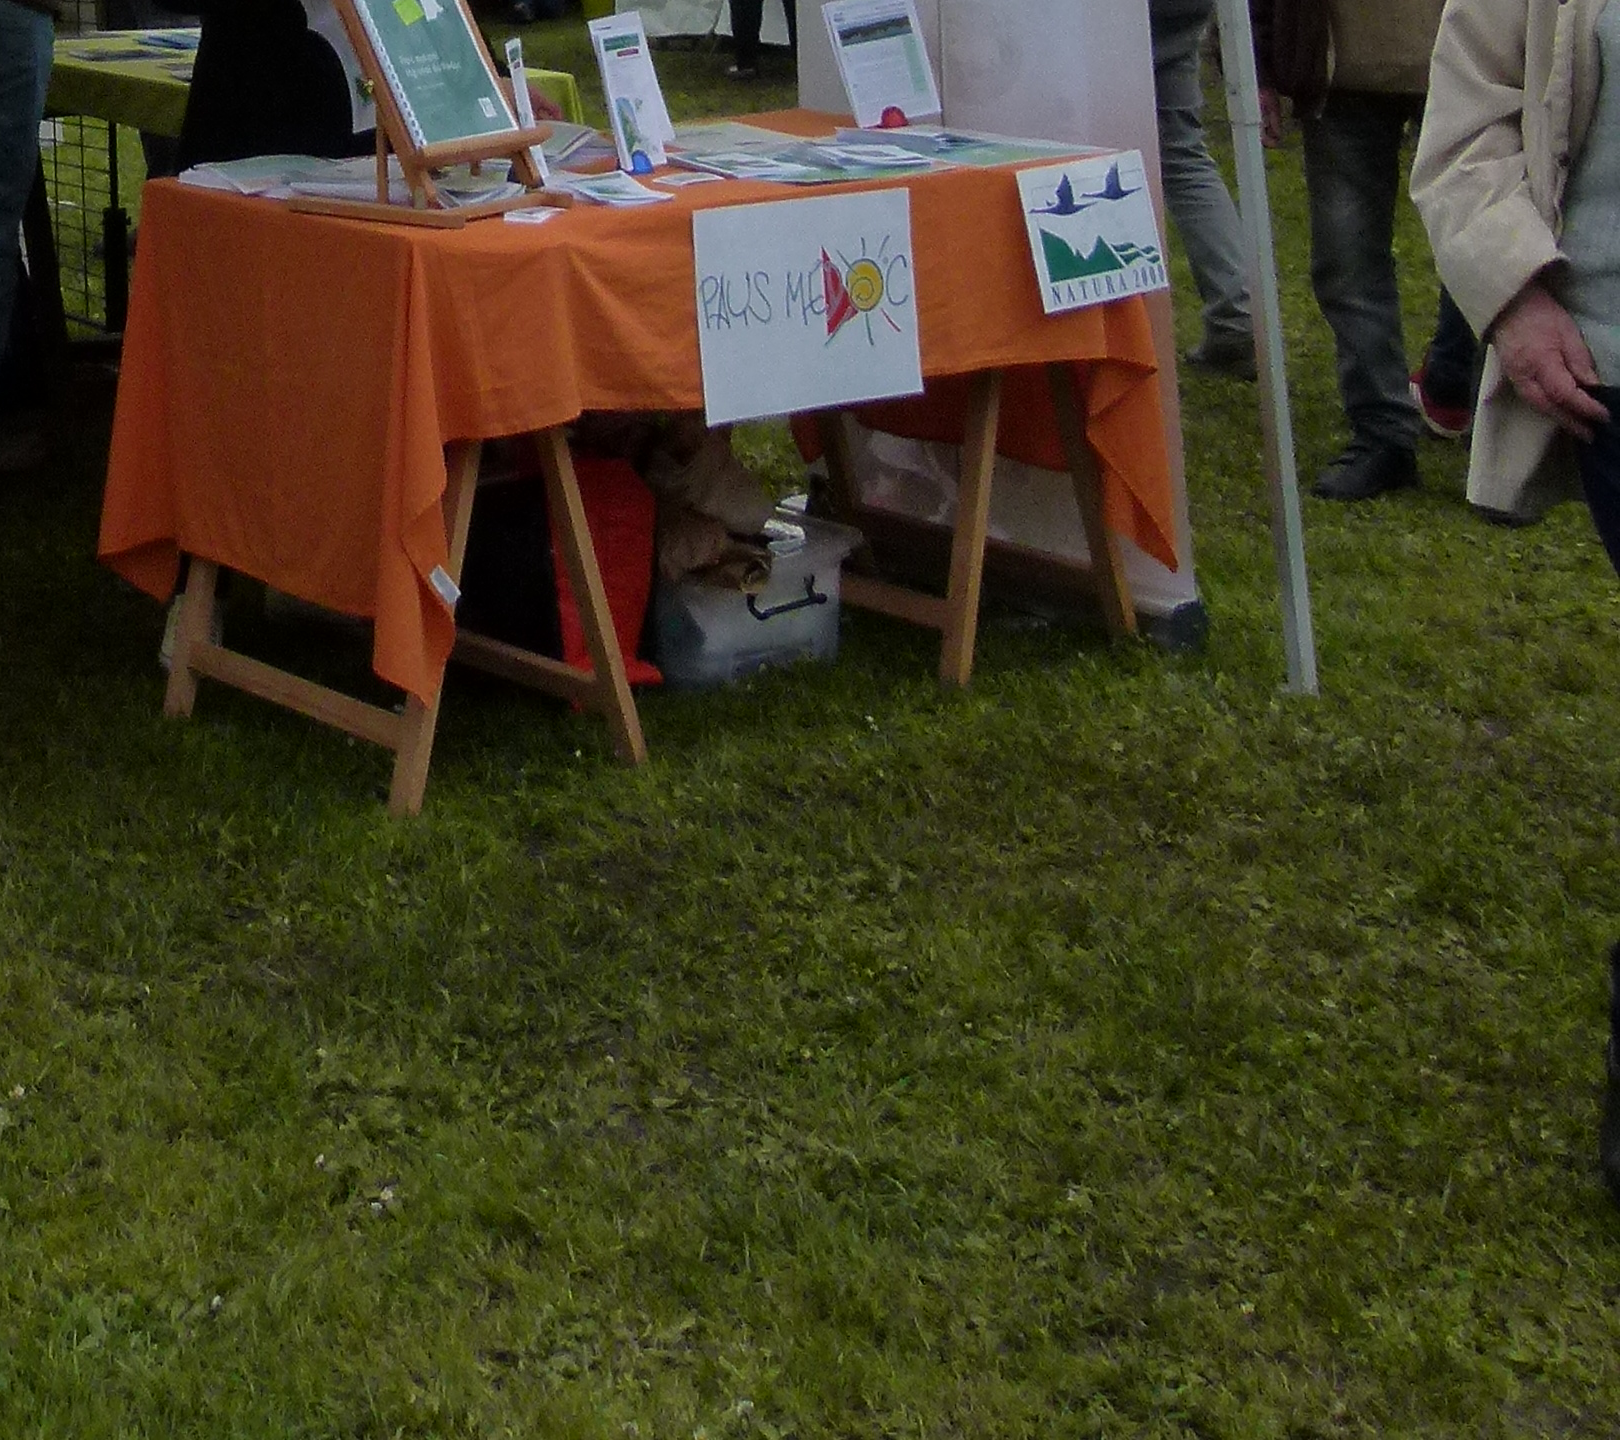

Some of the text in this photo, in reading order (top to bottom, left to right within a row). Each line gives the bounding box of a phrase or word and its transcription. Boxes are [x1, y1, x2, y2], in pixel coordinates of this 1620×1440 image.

[700, 270, 772, 330] PAYS
[1050, 263, 1165, 305] NATURA 2000
